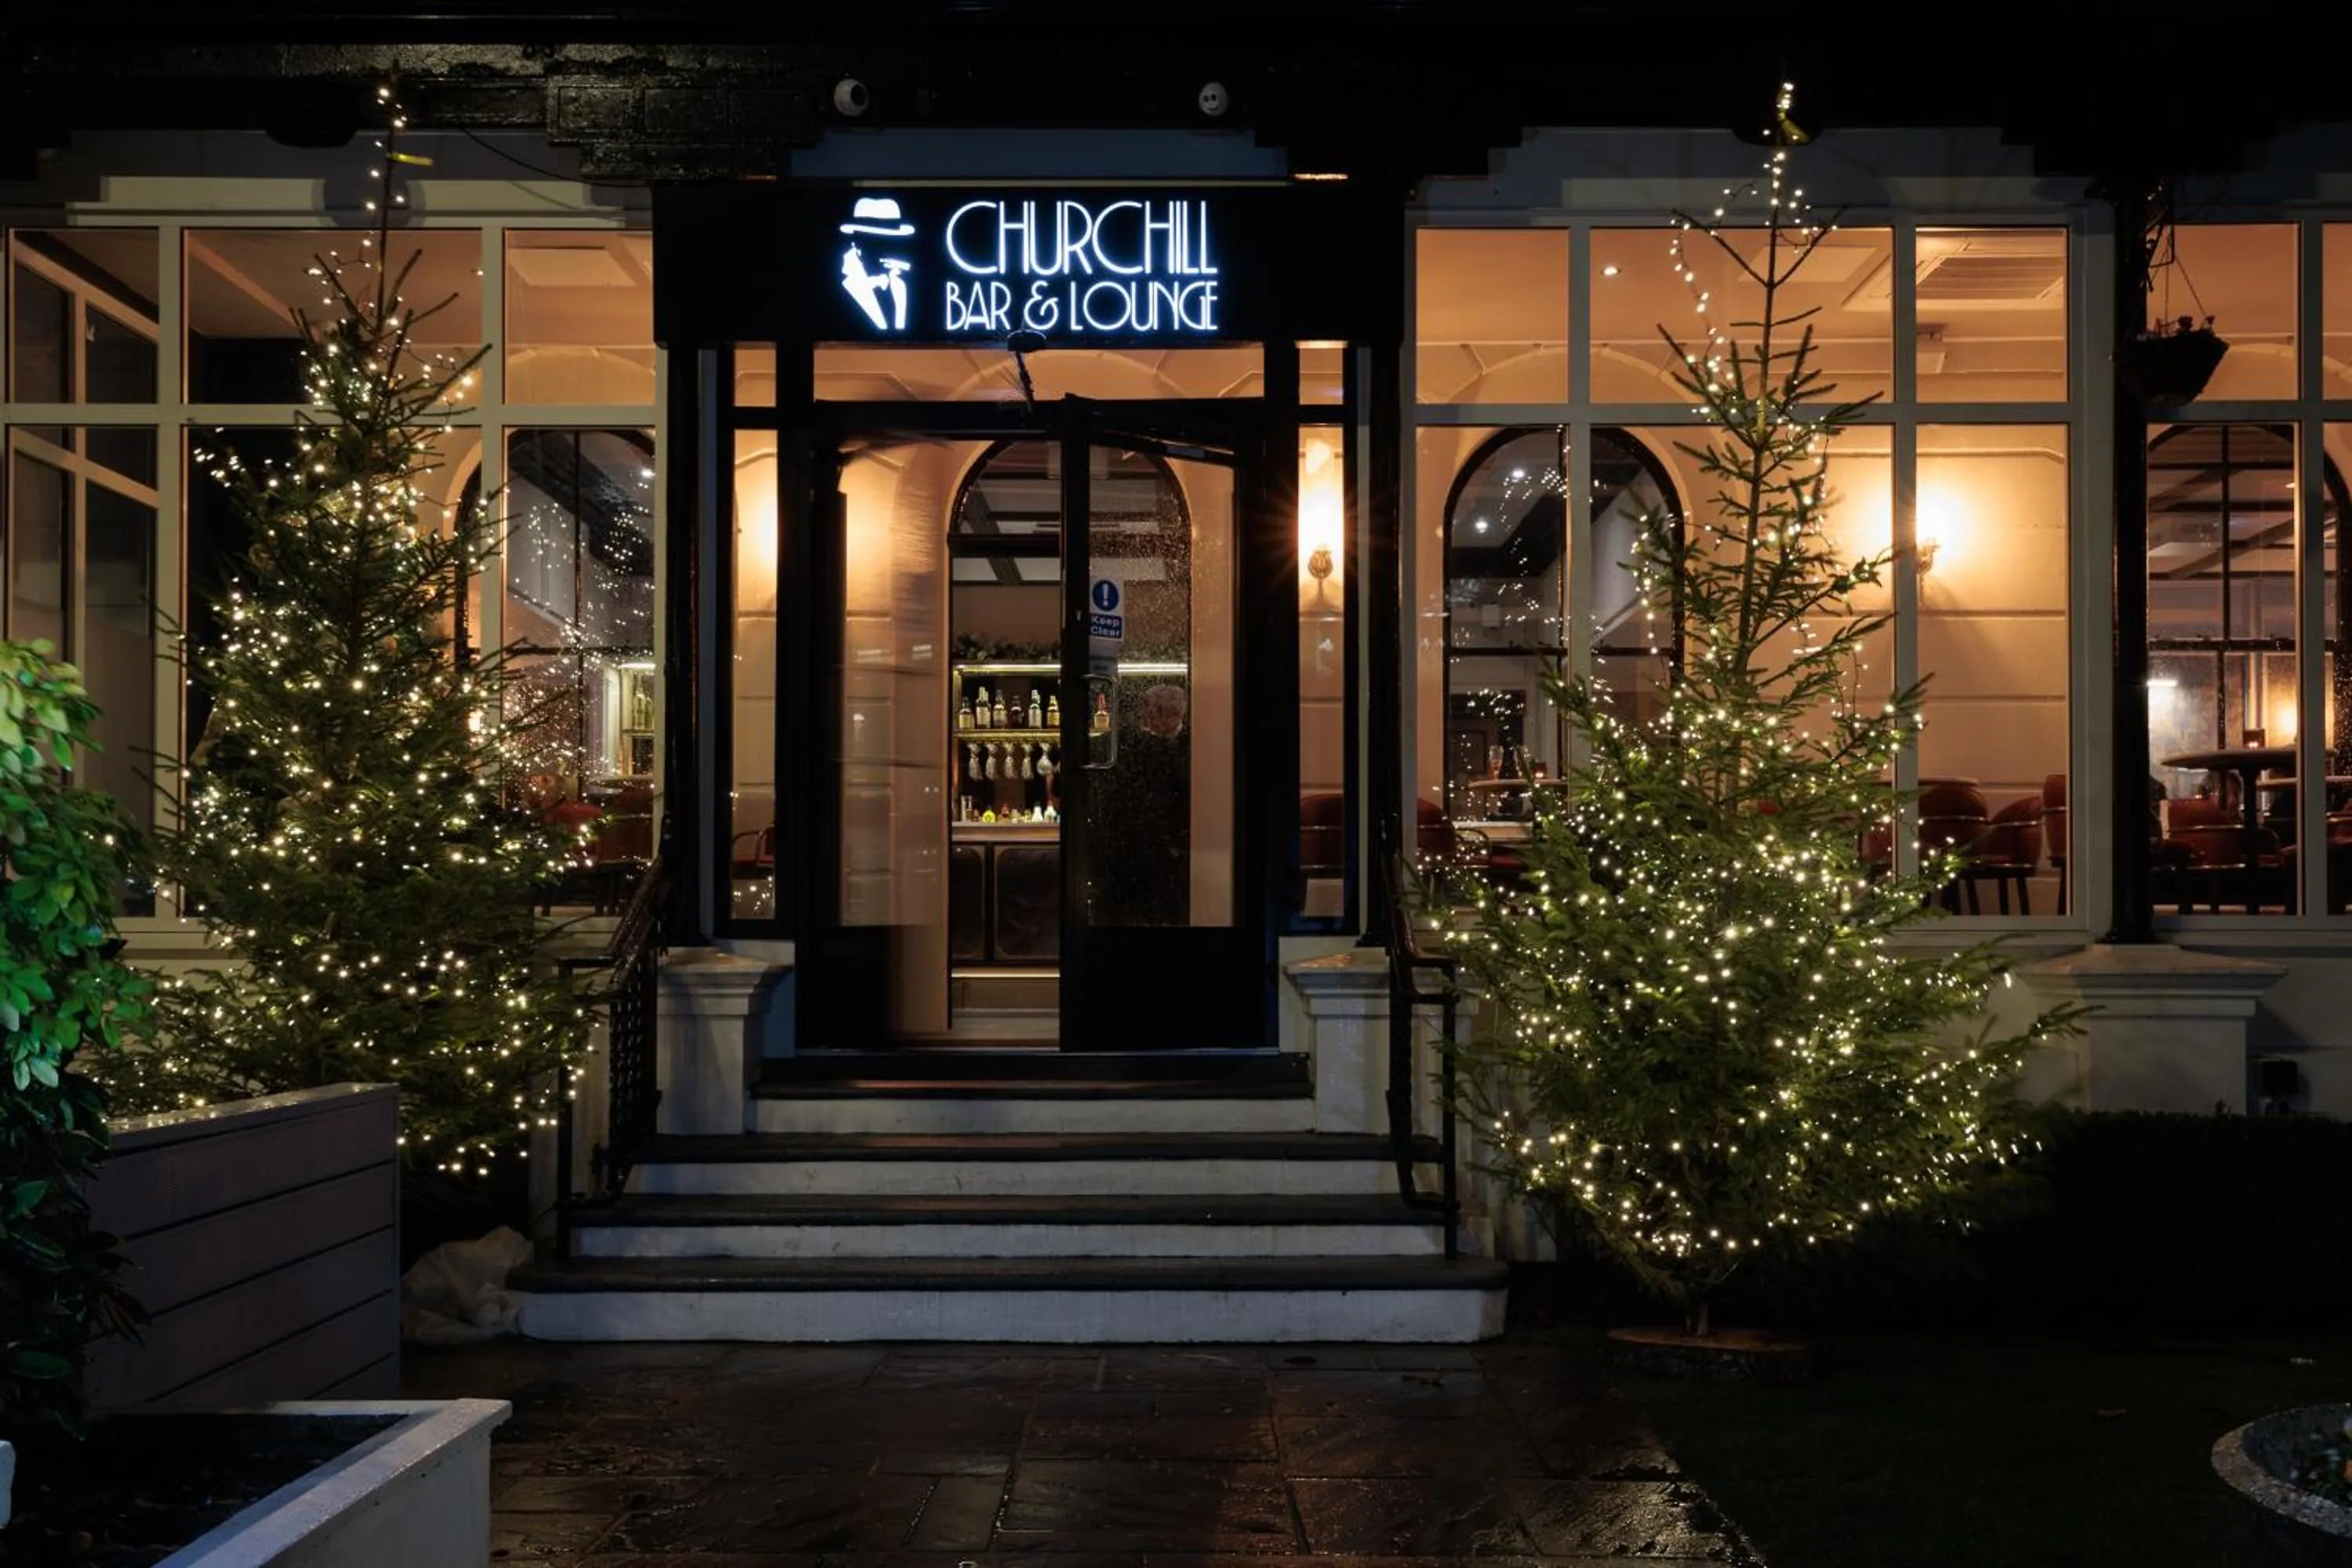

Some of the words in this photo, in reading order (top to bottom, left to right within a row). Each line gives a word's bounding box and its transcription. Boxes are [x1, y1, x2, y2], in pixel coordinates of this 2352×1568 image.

[946, 201, 1218, 274] CHURCHILL
[946, 281, 1011, 331] BAR
[1023, 280, 1058, 331] &
[1070, 281, 1218, 332] LOUNGE
[1091, 615, 1120, 627] Keep
[1091, 625, 1120, 637] Clear
